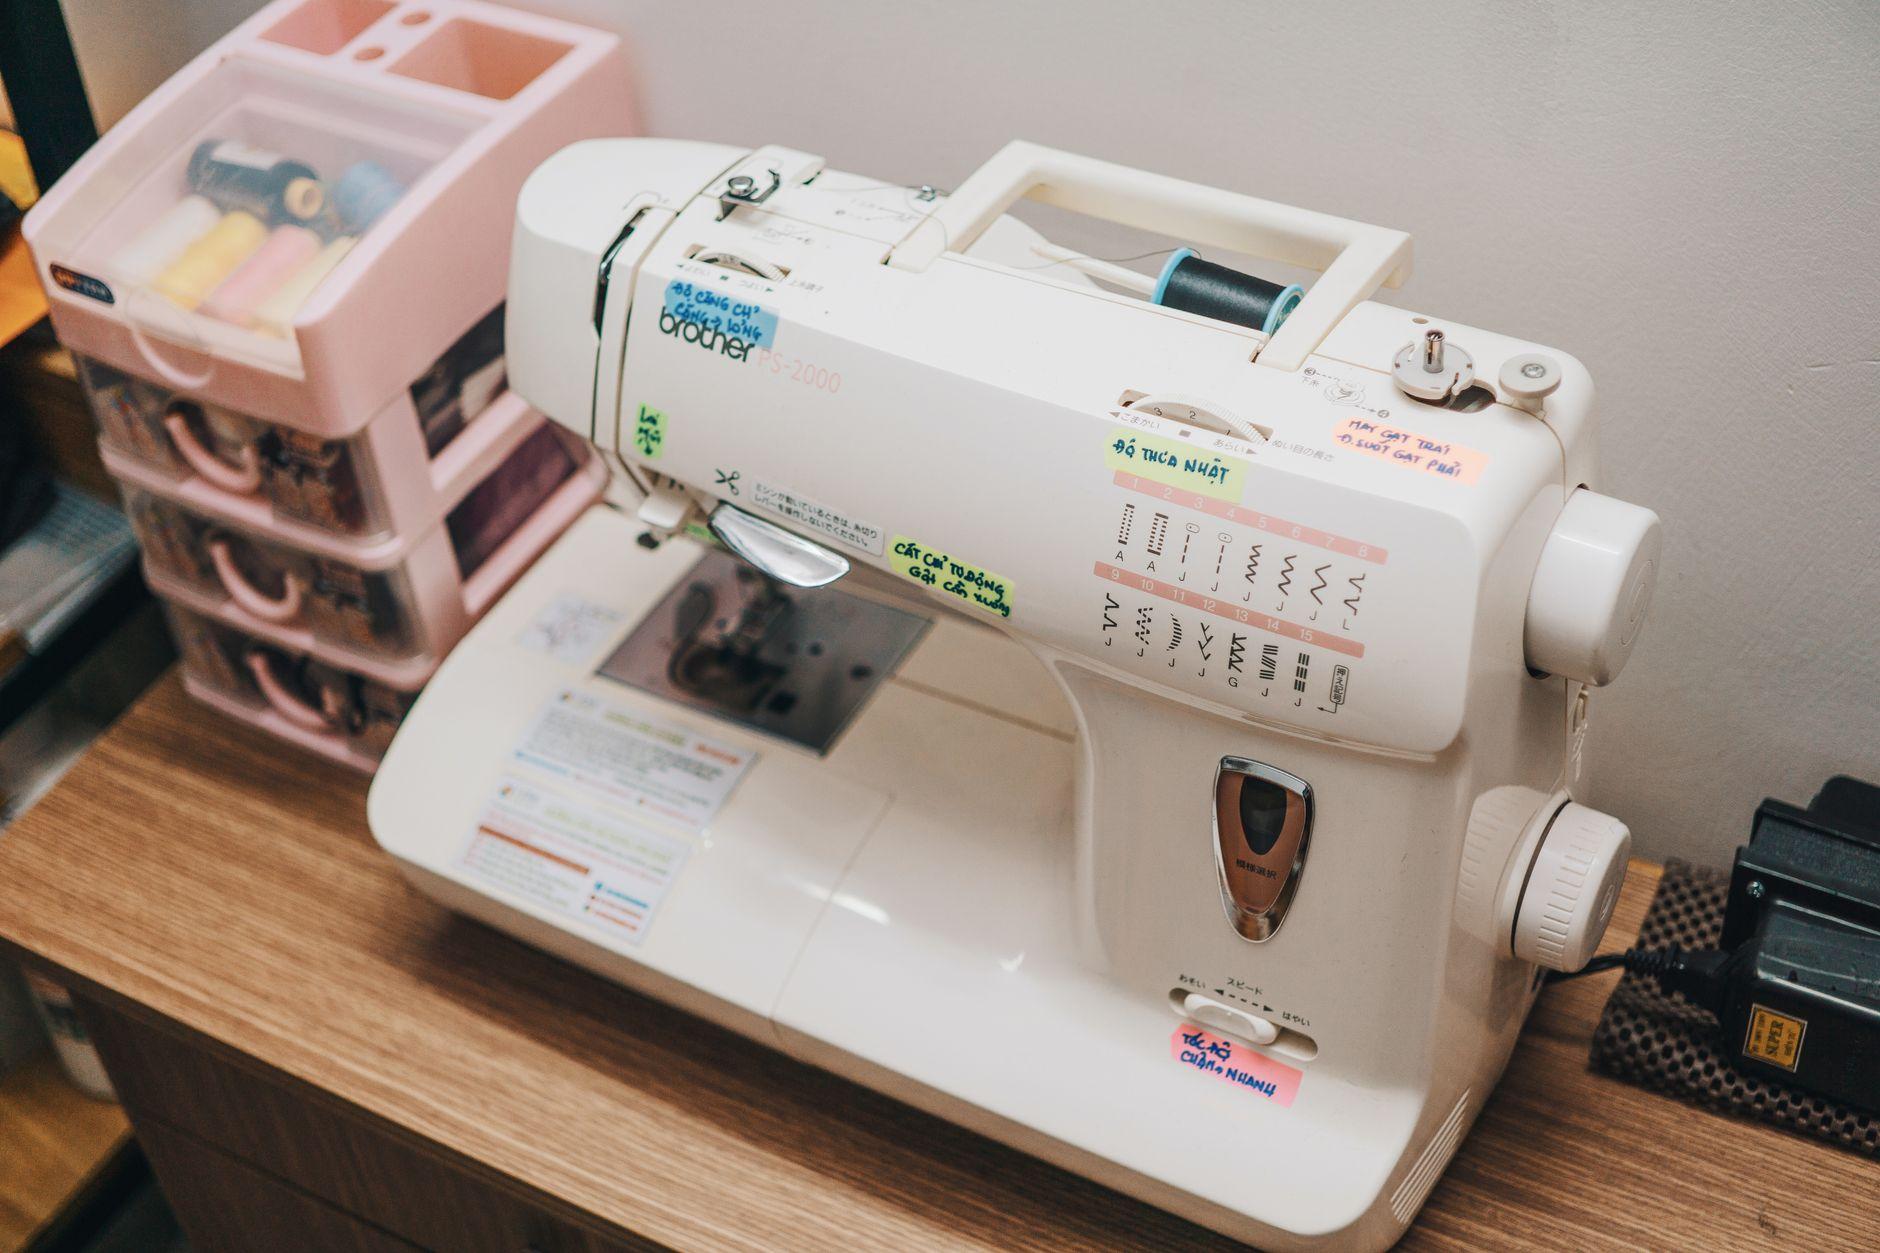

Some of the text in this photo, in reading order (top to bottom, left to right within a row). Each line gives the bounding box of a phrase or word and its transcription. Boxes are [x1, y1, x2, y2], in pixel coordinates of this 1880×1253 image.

[659, 306, 841, 394] brother PS-2000
[1120, 413, 1160, 430] こまかい
[1188, 410, 1197, 420] 2
[1213, 438, 1245, 455] あらい
[1273, 438, 1335, 463] ぬい目の長さ
[1132, 477, 1368, 557] 1 2 3 4 5 6 7 8
[1115, 551, 1125, 562] A
[1146, 561, 1156, 572] A
[1112, 570, 1313, 641] 9 10 11 12 13 14 15
[1228, 676, 1238, 688] G
[1227, 977, 1263, 996] スピード
[1282, 1010, 1311, 1027] はやい
[1765, 1020, 1784, 1057] SUPER
[1226, 1067, 1277, 1097] NHANH
